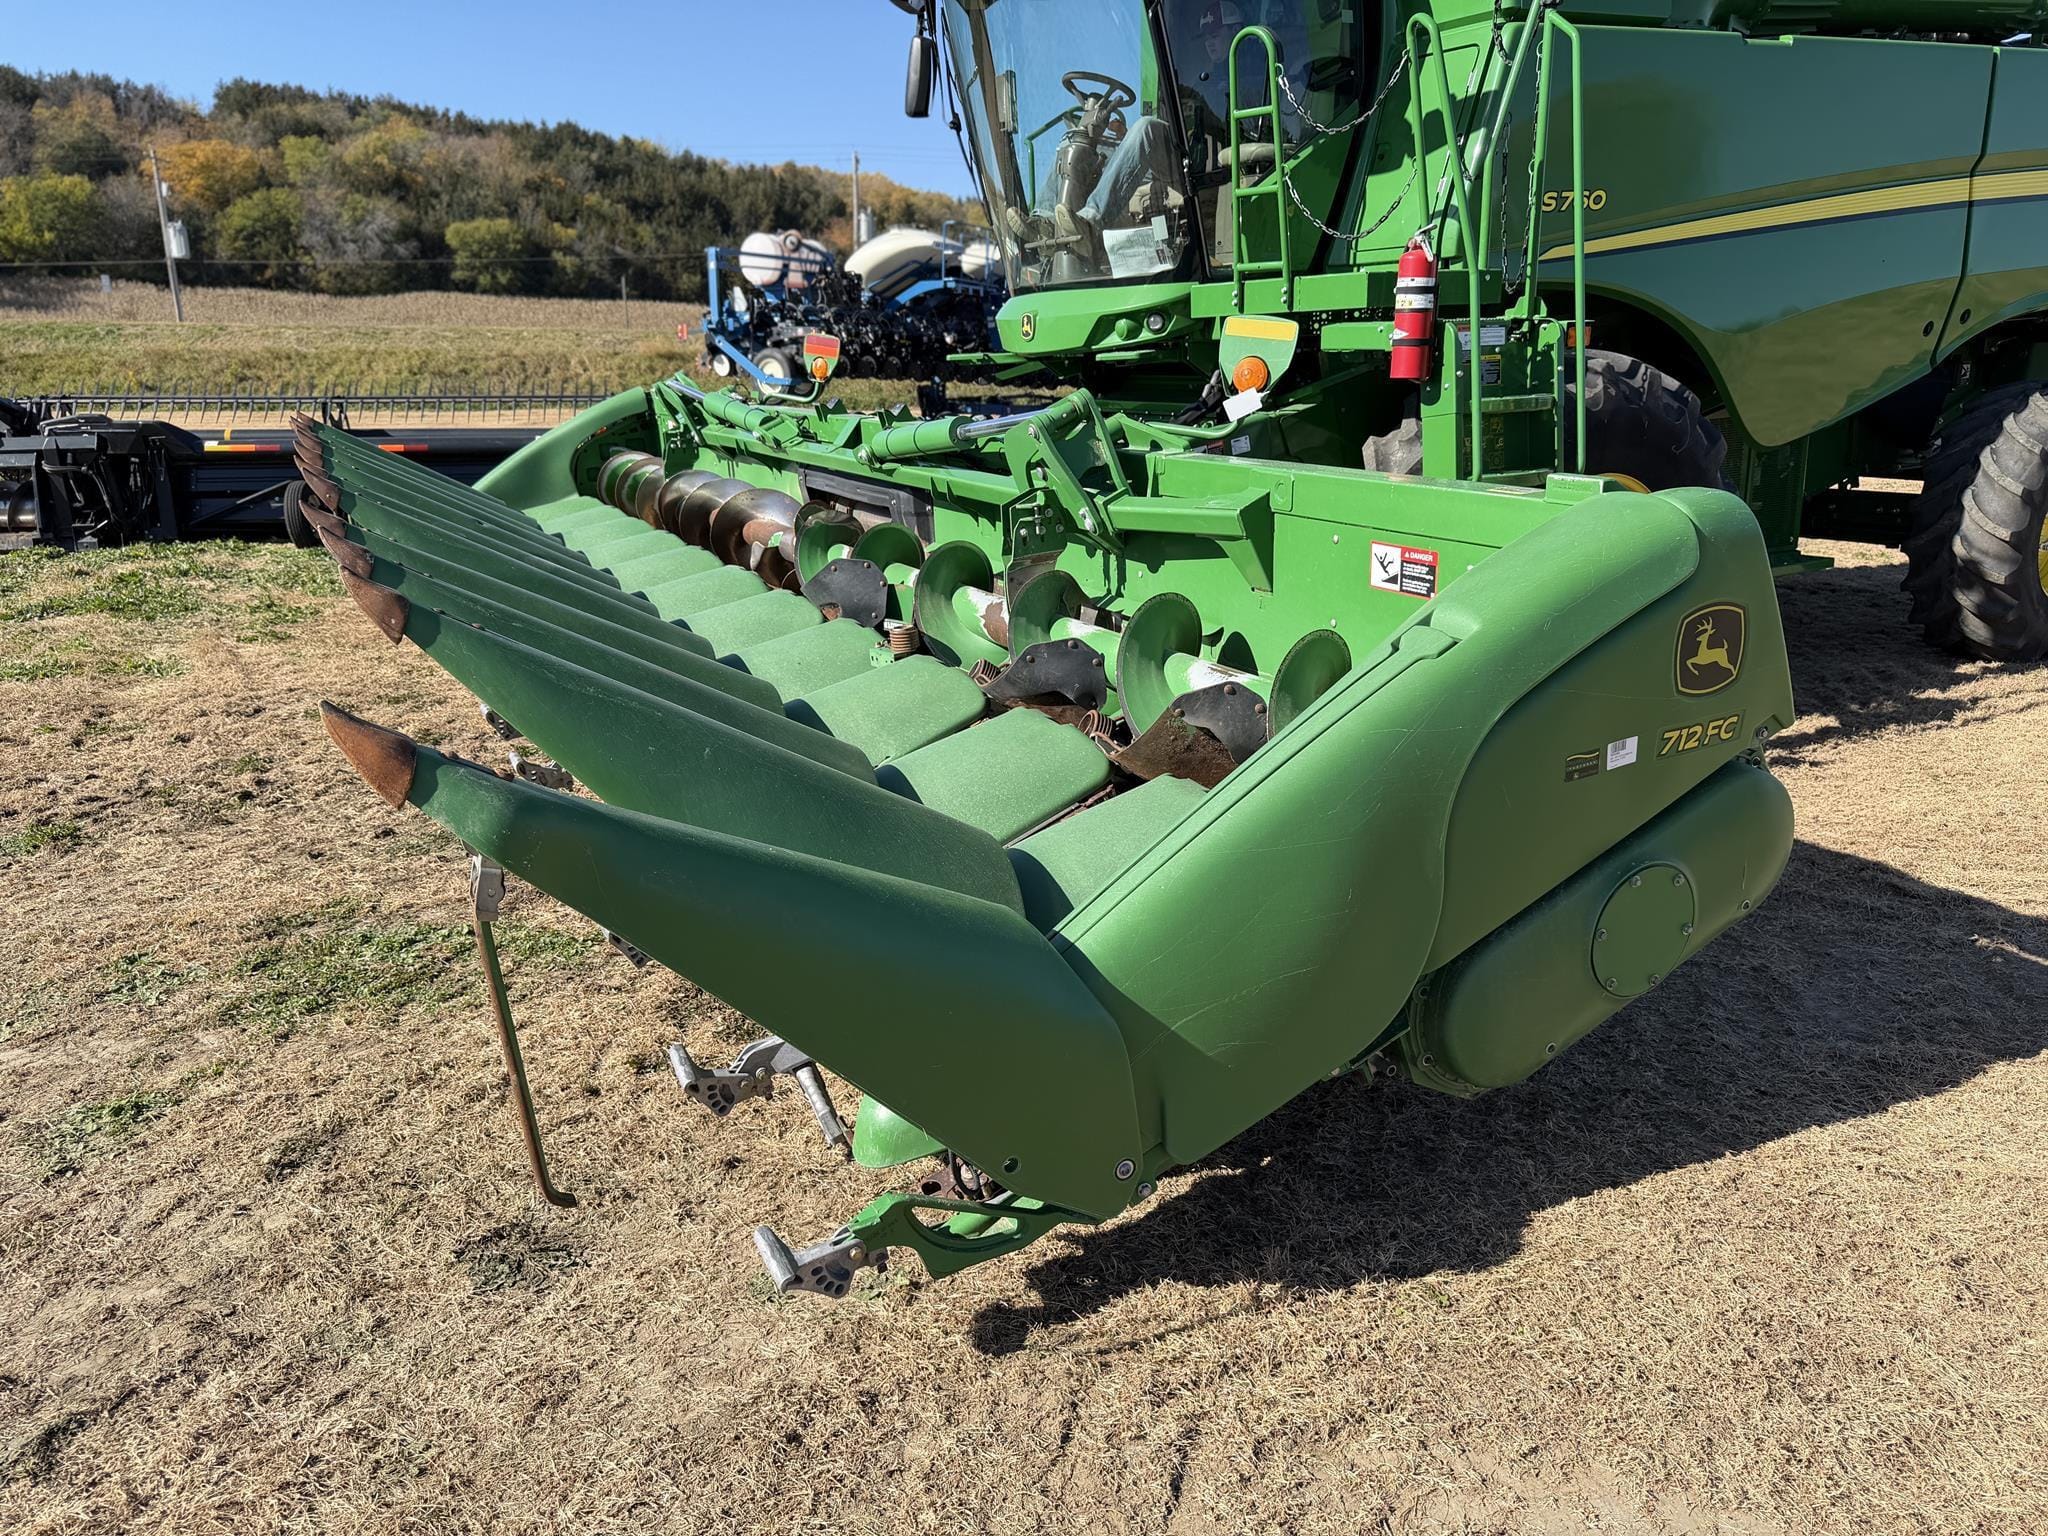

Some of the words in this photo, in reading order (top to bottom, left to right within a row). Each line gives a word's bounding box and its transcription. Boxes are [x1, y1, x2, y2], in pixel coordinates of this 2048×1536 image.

[1409, 551, 1433, 562] DANGER
[1659, 724, 1703, 755] 712
[1703, 715, 1739, 745] FC
